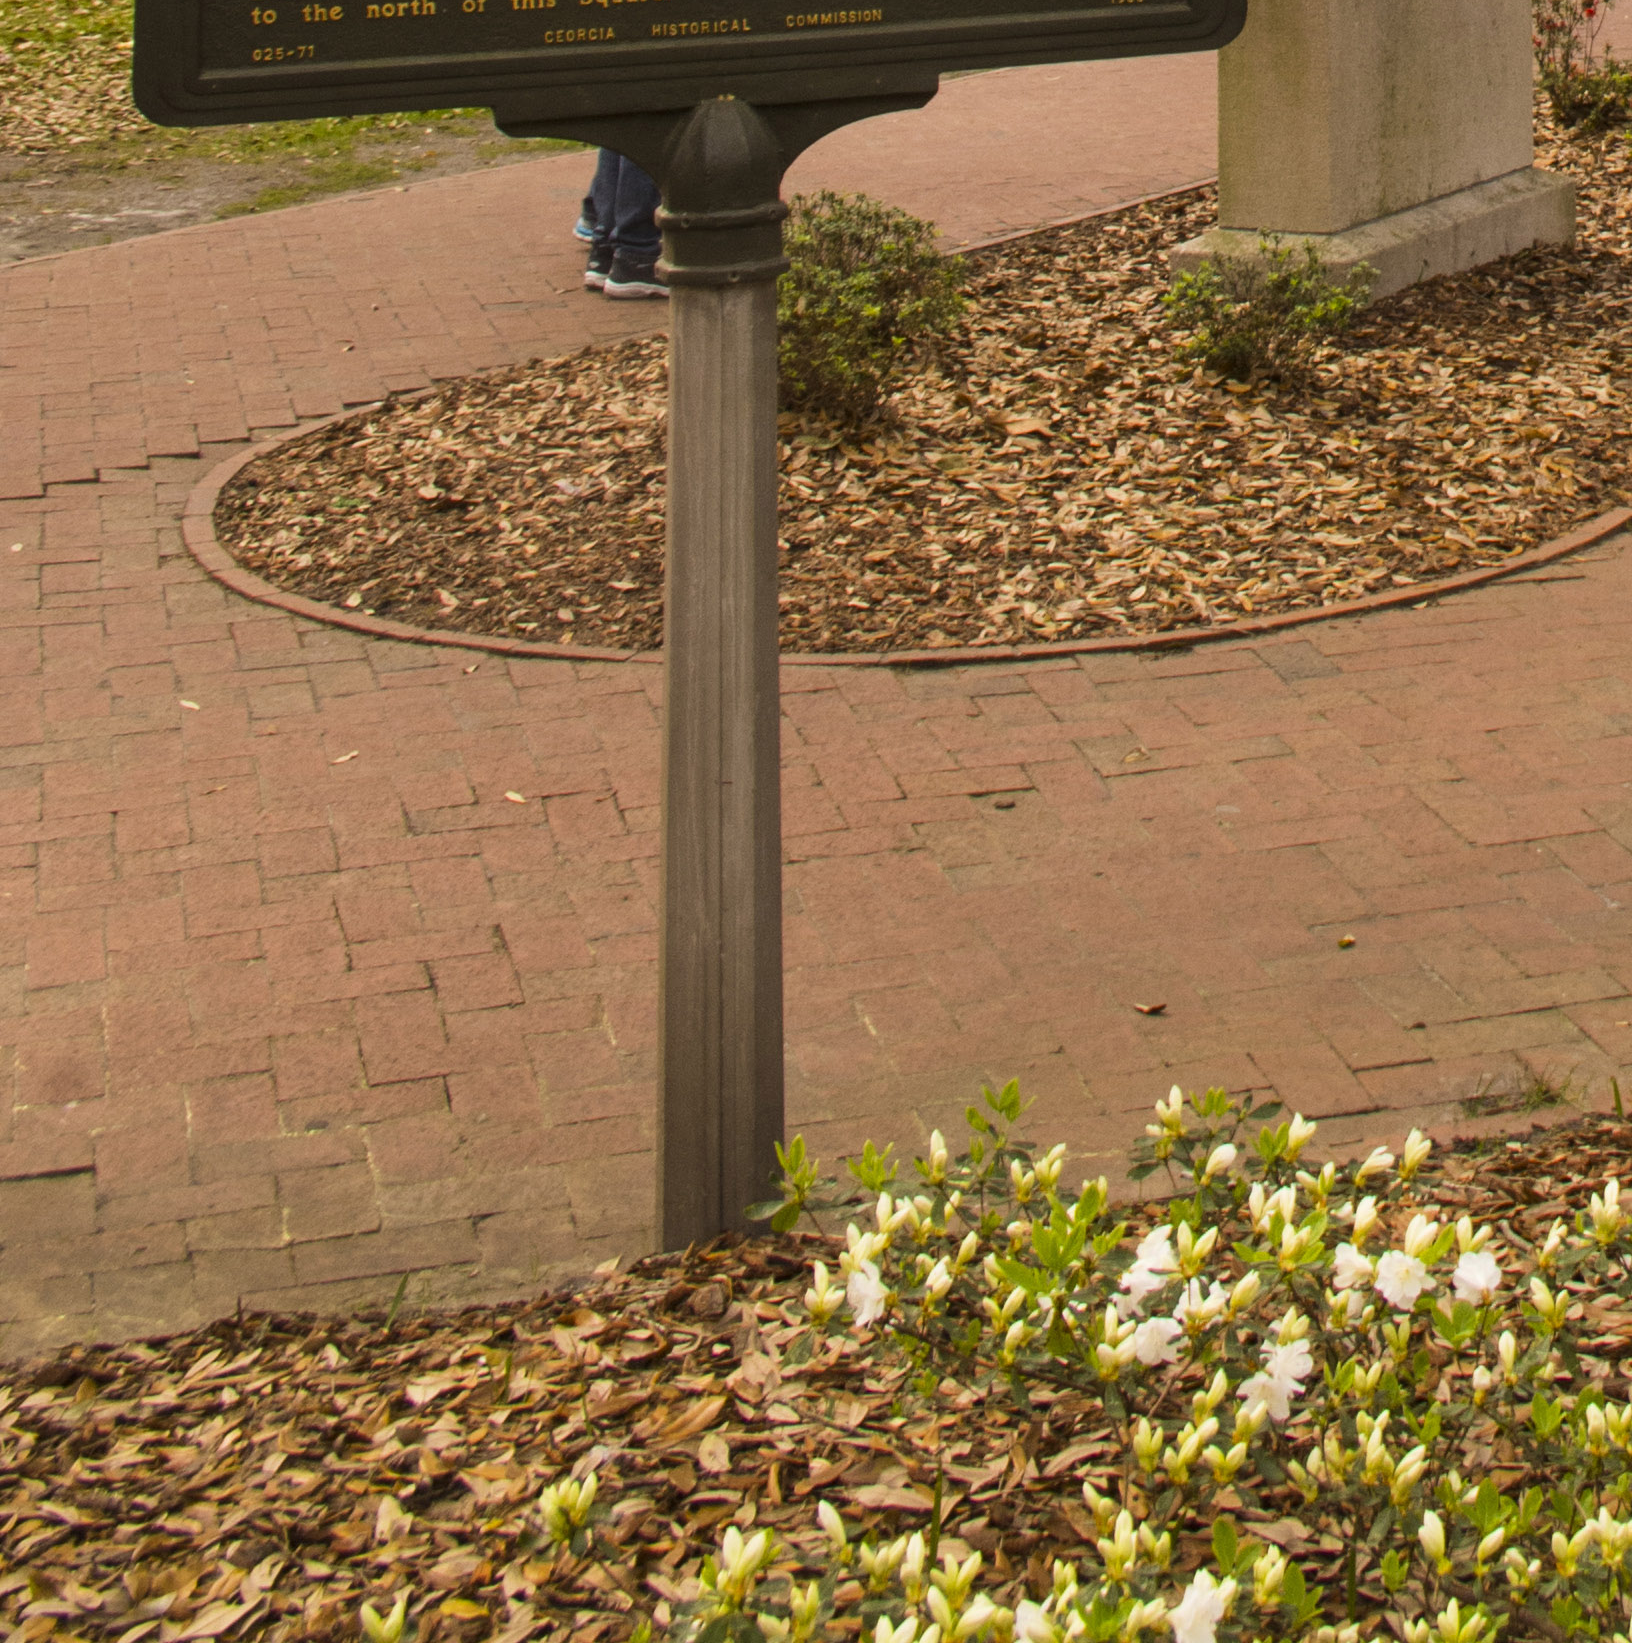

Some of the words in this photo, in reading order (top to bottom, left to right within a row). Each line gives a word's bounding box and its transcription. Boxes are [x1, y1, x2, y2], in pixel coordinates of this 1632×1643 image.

[249, 6, 278, 26] to
[300, 2, 344, 23] the
[544, 27, 616, 44] GEORGIA
[652, 18, 752, 38] HISTORICAL
[786, 8, 883, 28] COMMISSION
